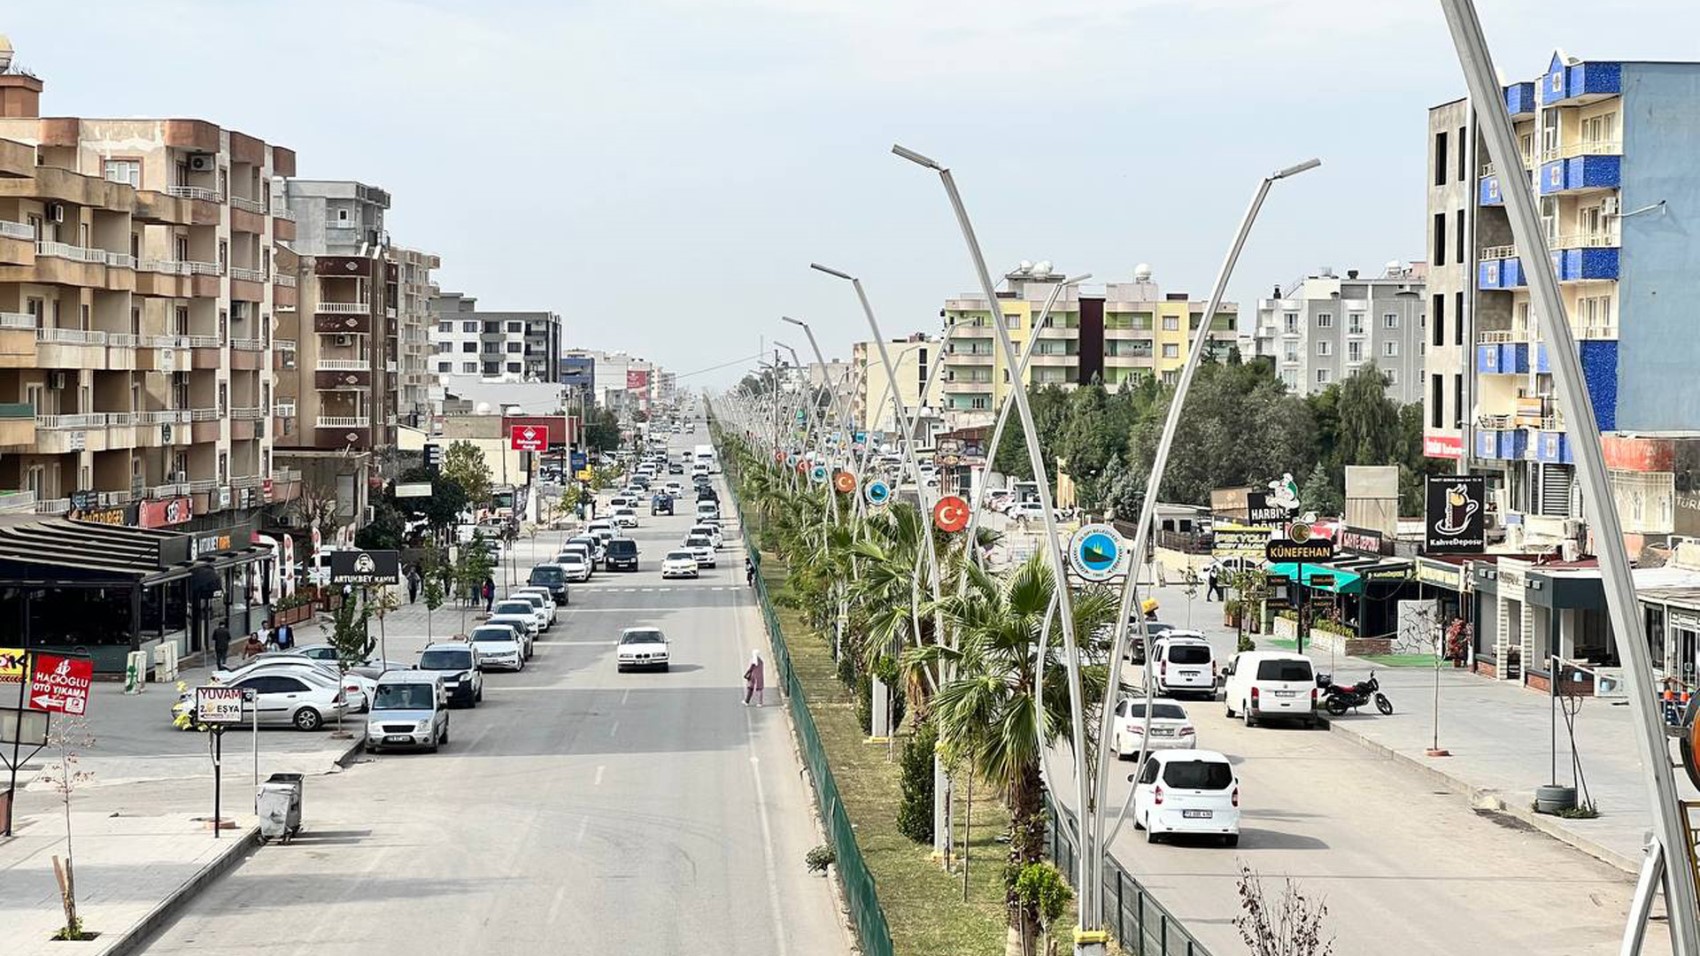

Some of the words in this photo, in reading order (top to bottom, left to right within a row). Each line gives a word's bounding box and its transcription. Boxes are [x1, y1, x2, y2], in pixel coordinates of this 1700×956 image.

[1676, 497, 1700, 509] TÜR
[1430, 538, 1482, 547] KahveDeposu
[1270, 546, 1331, 558] KÜNEFEHAN
[33, 683, 51, 692] OTO
[53, 686, 86, 698] YIKAMA
[200, 689, 241, 699] YUVAM
[217, 704, 240, 714] EŞYA
